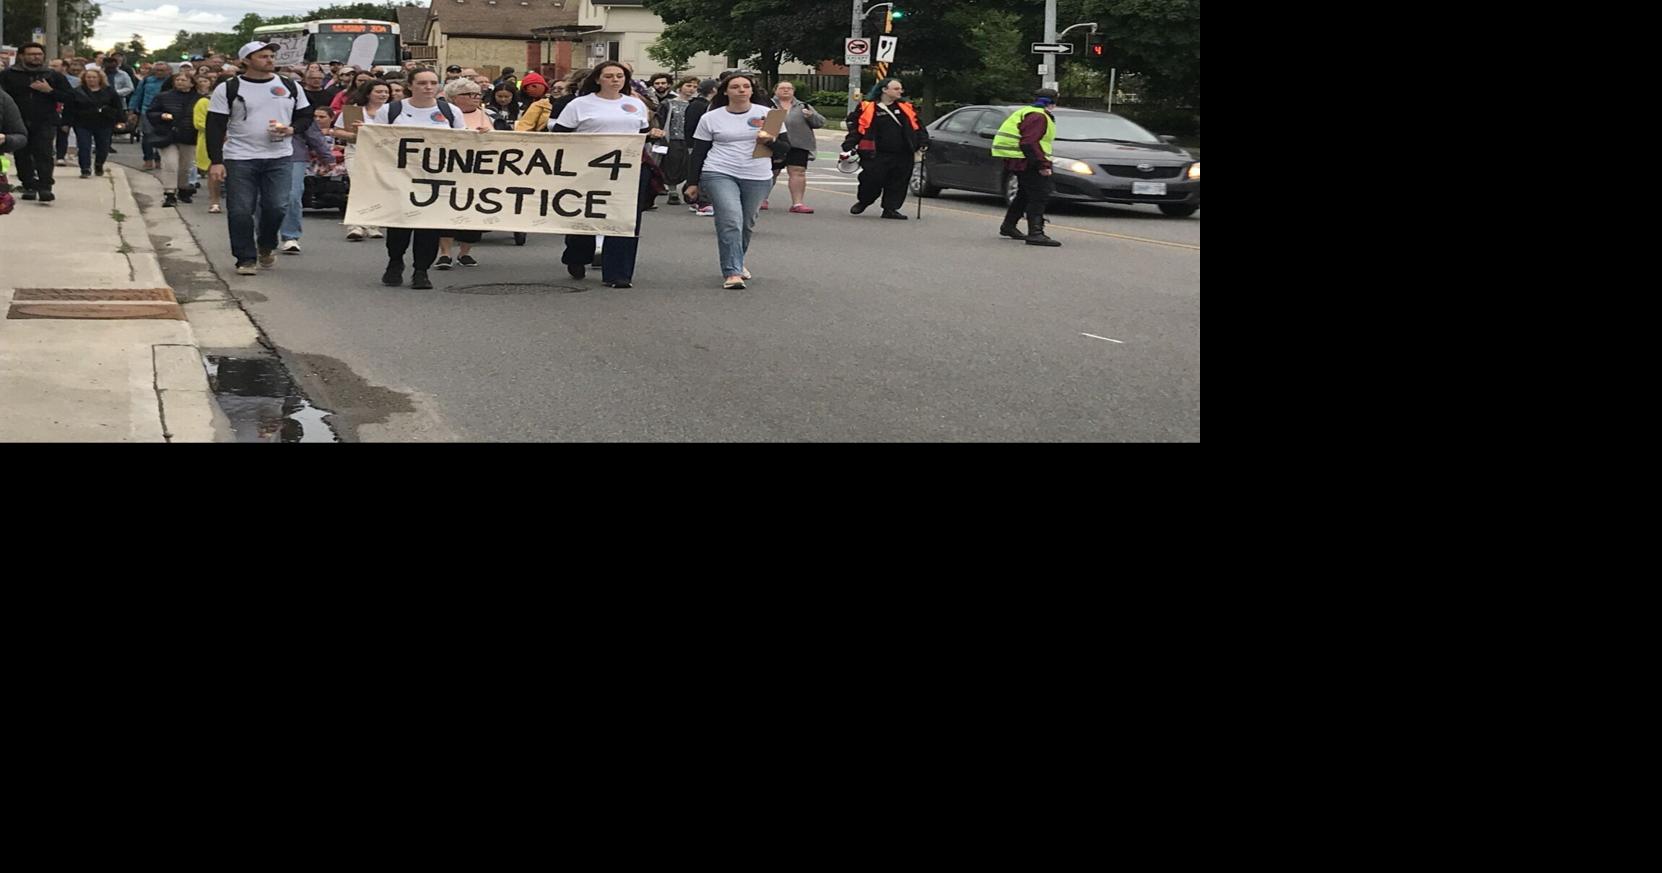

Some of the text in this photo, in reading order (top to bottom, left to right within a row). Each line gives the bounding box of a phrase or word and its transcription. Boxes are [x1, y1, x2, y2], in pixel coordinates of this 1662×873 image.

[397, 137, 632, 180] FUNERAL 4
[409, 178, 612, 219] JUSTICE
